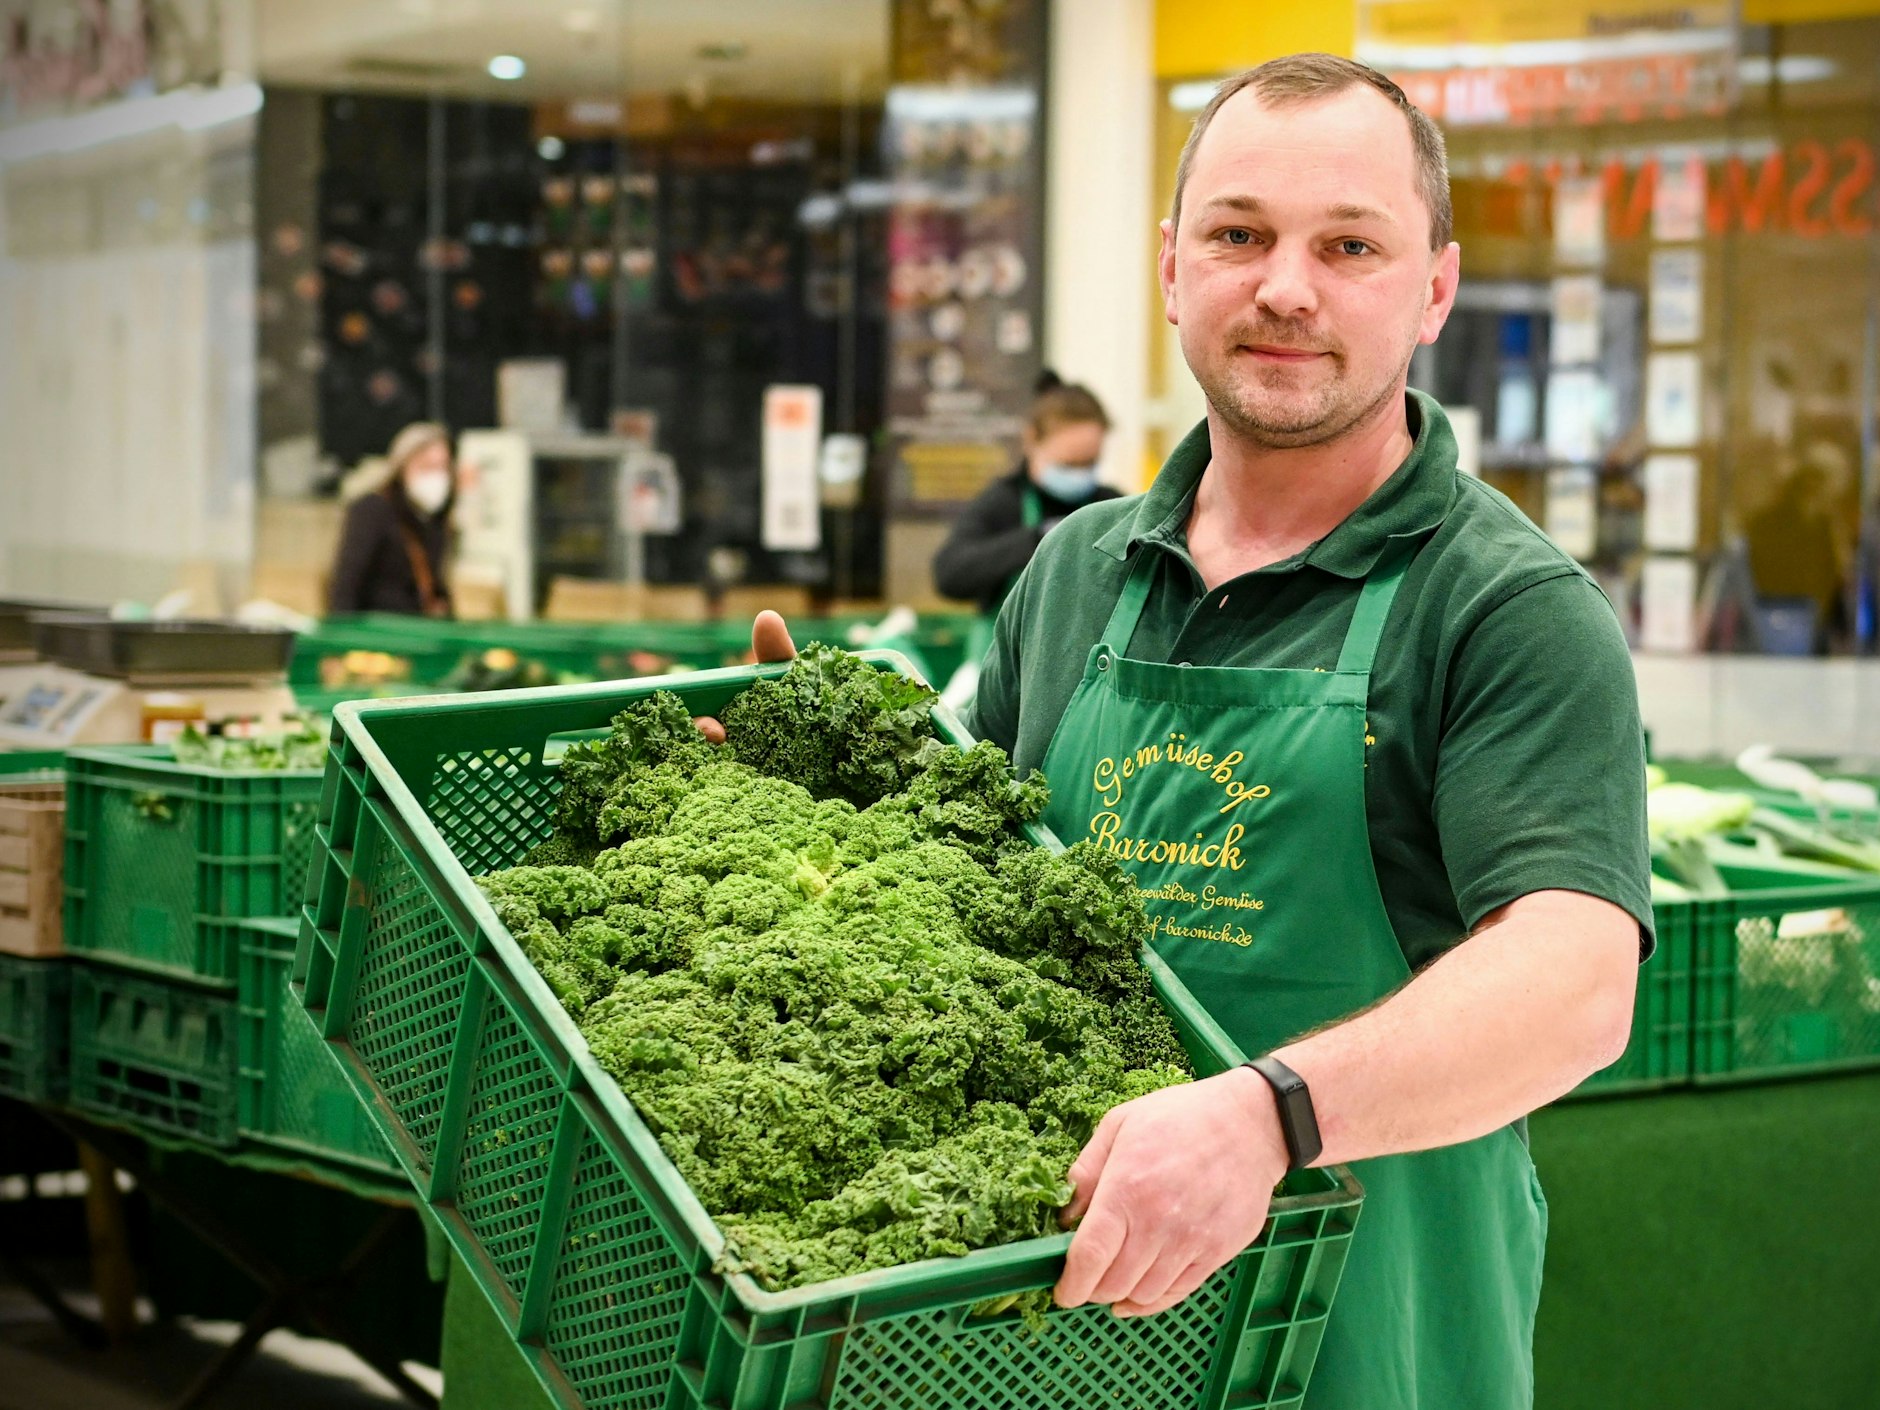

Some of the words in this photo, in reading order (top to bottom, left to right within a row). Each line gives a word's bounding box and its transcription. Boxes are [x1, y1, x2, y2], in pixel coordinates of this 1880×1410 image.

[1094, 732, 1271, 814] Gemüsehof
[1090, 811, 1246, 871] Baronick
[1130, 882, 1198, 903] reewälder
[1201, 885, 1264, 910] Gemüse
